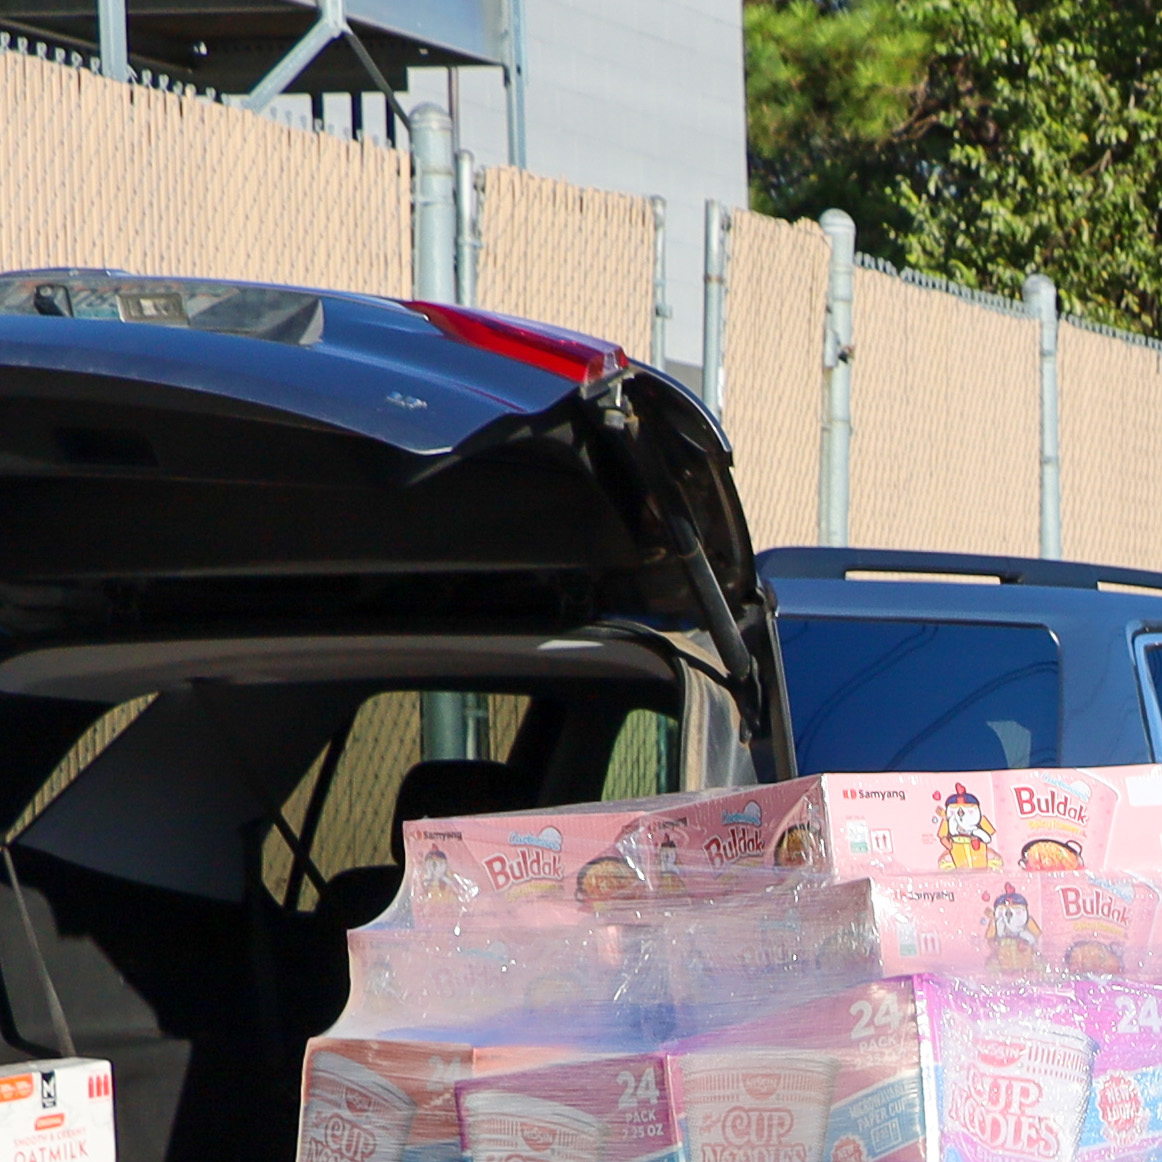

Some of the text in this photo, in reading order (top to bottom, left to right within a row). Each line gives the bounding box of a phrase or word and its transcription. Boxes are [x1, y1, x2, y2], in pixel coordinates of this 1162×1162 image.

[858, 789, 906, 801] Samyang
[1013, 787, 1088, 824] Buldak
[423, 831, 463, 841] Samyang
[704, 826, 764, 868] Buldak
[484, 849, 563, 891] Buldak
[1061, 885, 1132, 927] Buldak
[850, 995, 902, 1040] 24
[1117, 996, 1162, 1034] 24
[859, 1035, 897, 1054] PACK
[616, 1069, 660, 1108] 24
[967, 1063, 1044, 1111] CUP
[625, 1108, 656, 1123] PACK
[647, 1122, 664, 1138] OZ
[722, 1107, 793, 1148] CUP
[856, 1108, 889, 1133] PAPER
[948, 1081, 1061, 1159] NOODLES
[325, 1114, 376, 1162] CUP
